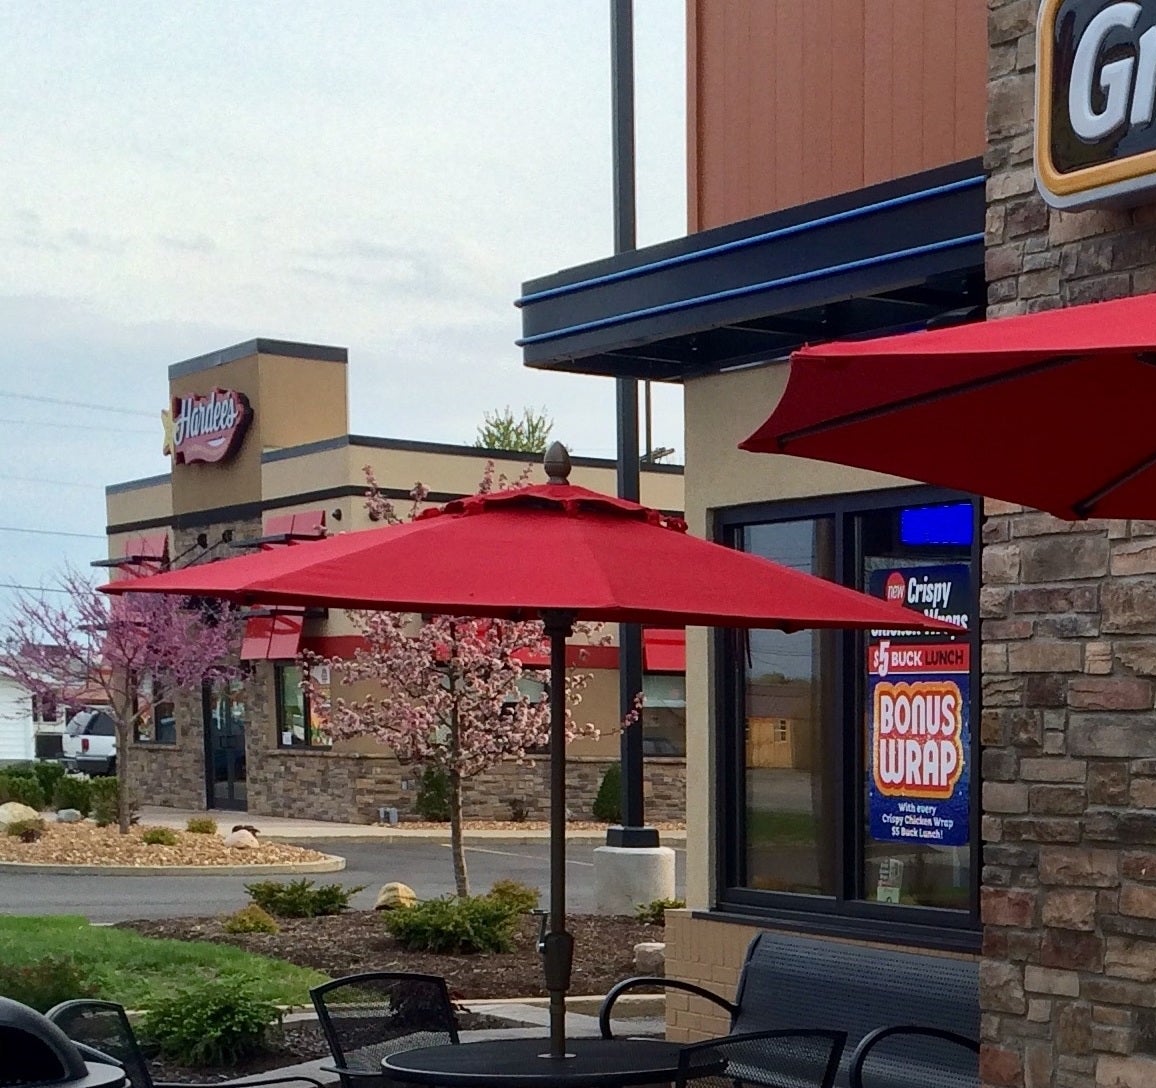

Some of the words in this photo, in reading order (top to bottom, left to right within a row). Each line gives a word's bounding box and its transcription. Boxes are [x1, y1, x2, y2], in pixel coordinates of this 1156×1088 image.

[907, 576, 952, 608] Crispy
[891, 650, 922, 667] BUCK
[925, 649, 964, 666] LUNCH
[880, 694, 956, 736] BONUS
[880, 738, 957, 786] WRAP
[898, 802, 916, 813] With
[917, 805, 937, 816] every
[882, 813, 904, 826] Crispy
[904, 815, 933, 826] Chicken
[933, 817, 954, 830] Wrap
[891, 826, 900, 836] $5
[901, 827, 918, 838] Buck
[919, 829, 944, 839] Lunch!
